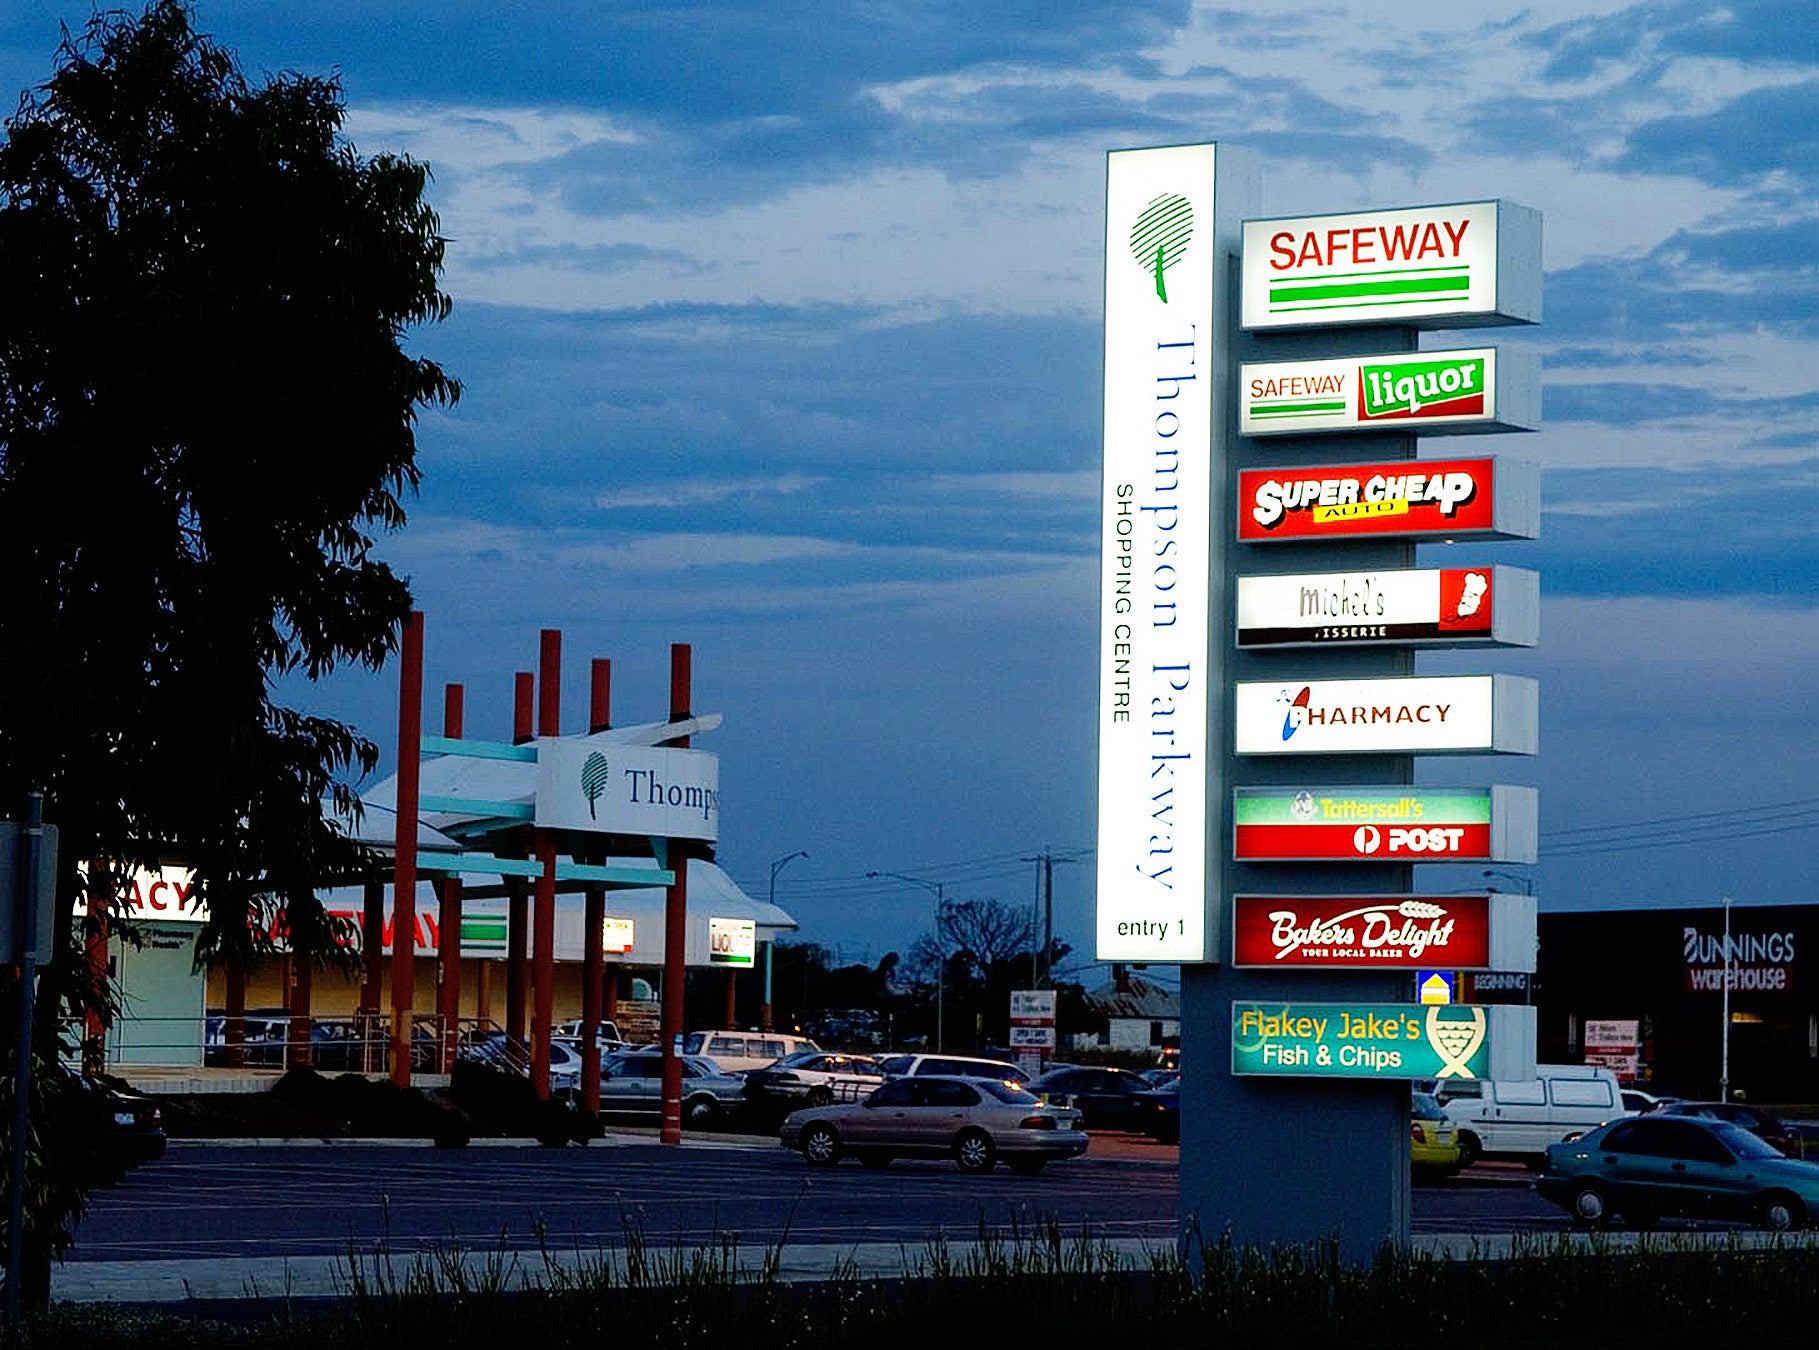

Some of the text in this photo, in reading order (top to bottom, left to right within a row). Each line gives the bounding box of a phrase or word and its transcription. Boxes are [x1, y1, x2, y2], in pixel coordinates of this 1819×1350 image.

[1270, 219, 1470, 270] SAFEWAY
[1251, 374, 1346, 398] SAFEWAY
[1368, 363, 1476, 414] liquor
[1253, 472, 1475, 526] SUPER CHEAP
[1325, 503, 1394, 518] AUTO
[1113, 484, 1133, 723] SHOPPING CENTRE
[1136, 323, 1197, 890] Thompson Parkway
[1320, 799, 1423, 819] Tattersall's
[1389, 828, 1464, 852] POST
[1118, 918, 1185, 940] entry 1
[1269, 911, 1455, 960] Bakers Delight
[1683, 927, 1795, 963] BUNNINGS
[1302, 949, 1329, 958] YOUR
[1332, 949, 1366, 958] LOCAL
[1690, 959, 1786, 990] warehouse
[1241, 1010, 1420, 1043] Flakey Jake's
[1263, 1044, 1402, 1071] Fish & Chips
